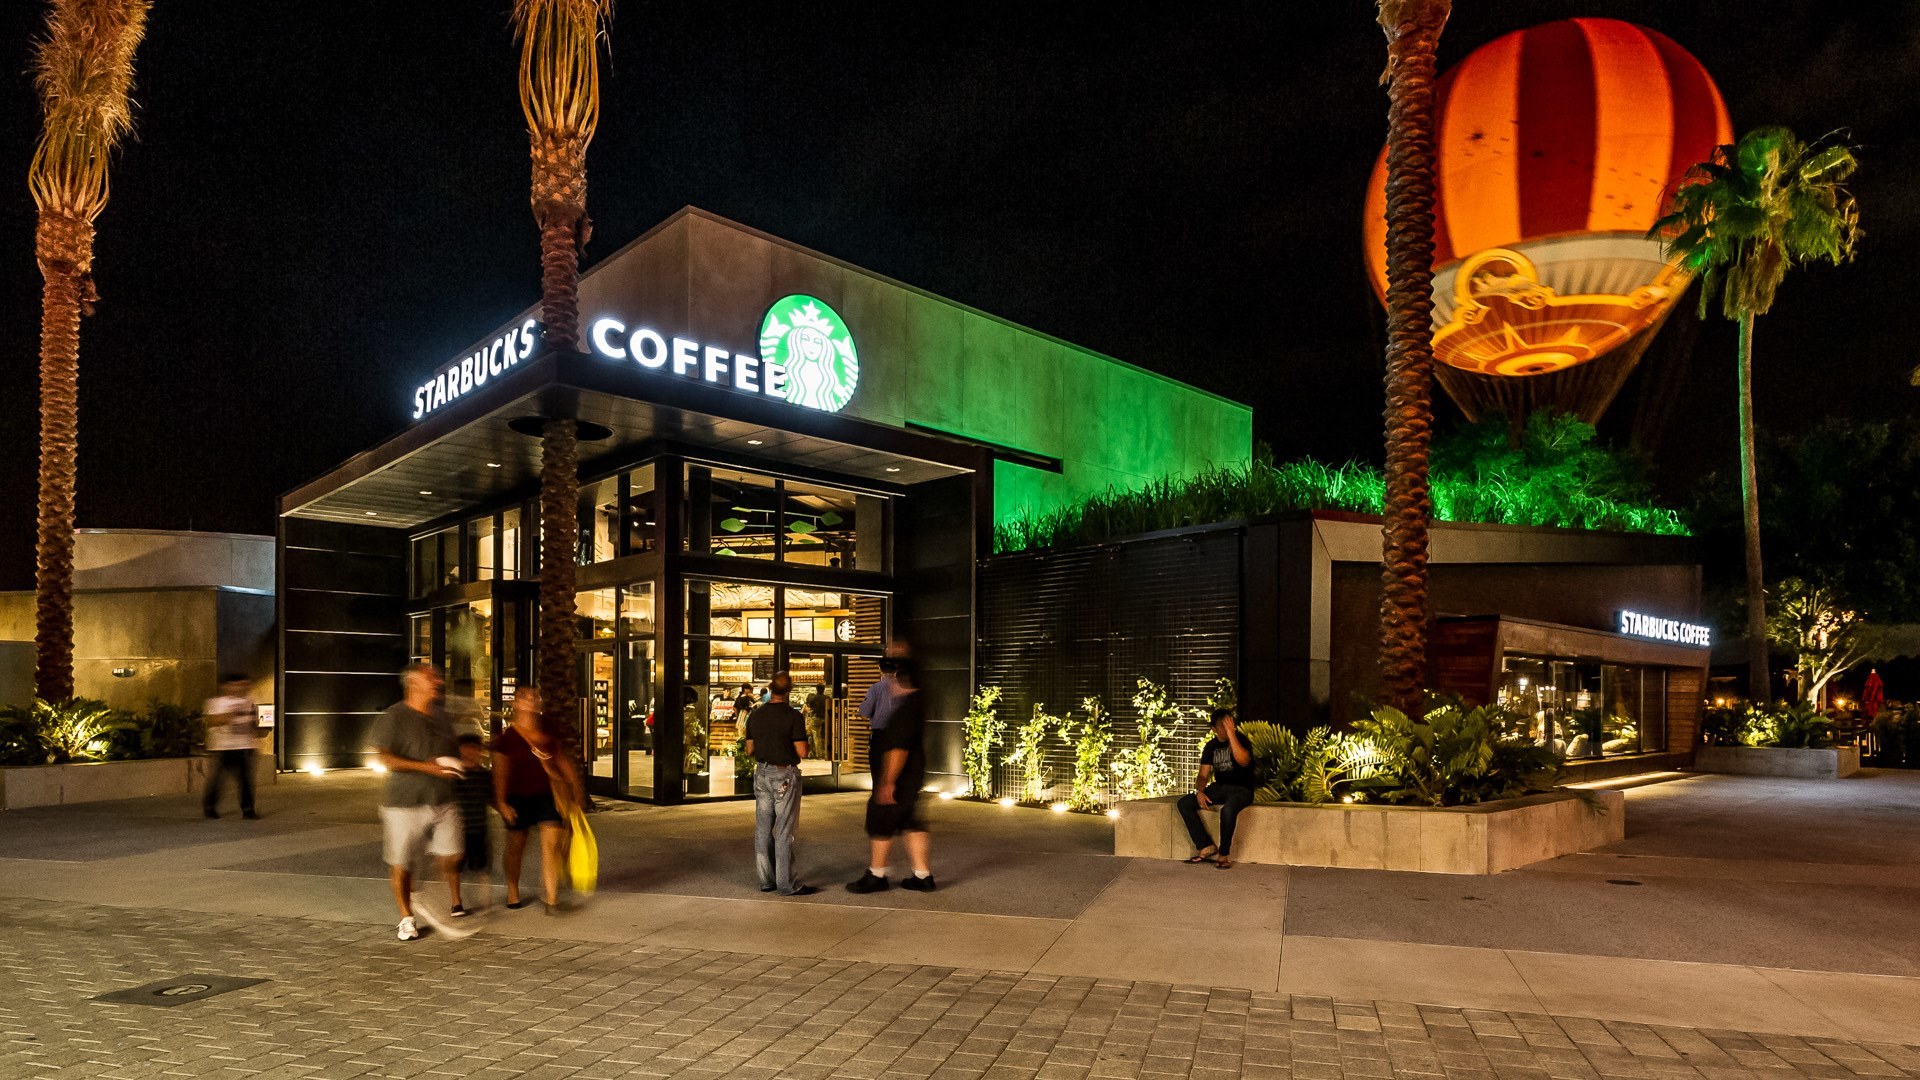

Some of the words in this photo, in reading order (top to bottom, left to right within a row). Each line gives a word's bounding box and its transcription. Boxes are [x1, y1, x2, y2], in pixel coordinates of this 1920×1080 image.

[413, 319, 536, 419] STARBUCKS
[592, 318, 788, 398] COFFEE
[1621, 610, 1680, 642] STARBUCKS
[1680, 622, 1710, 647] COFFEE
